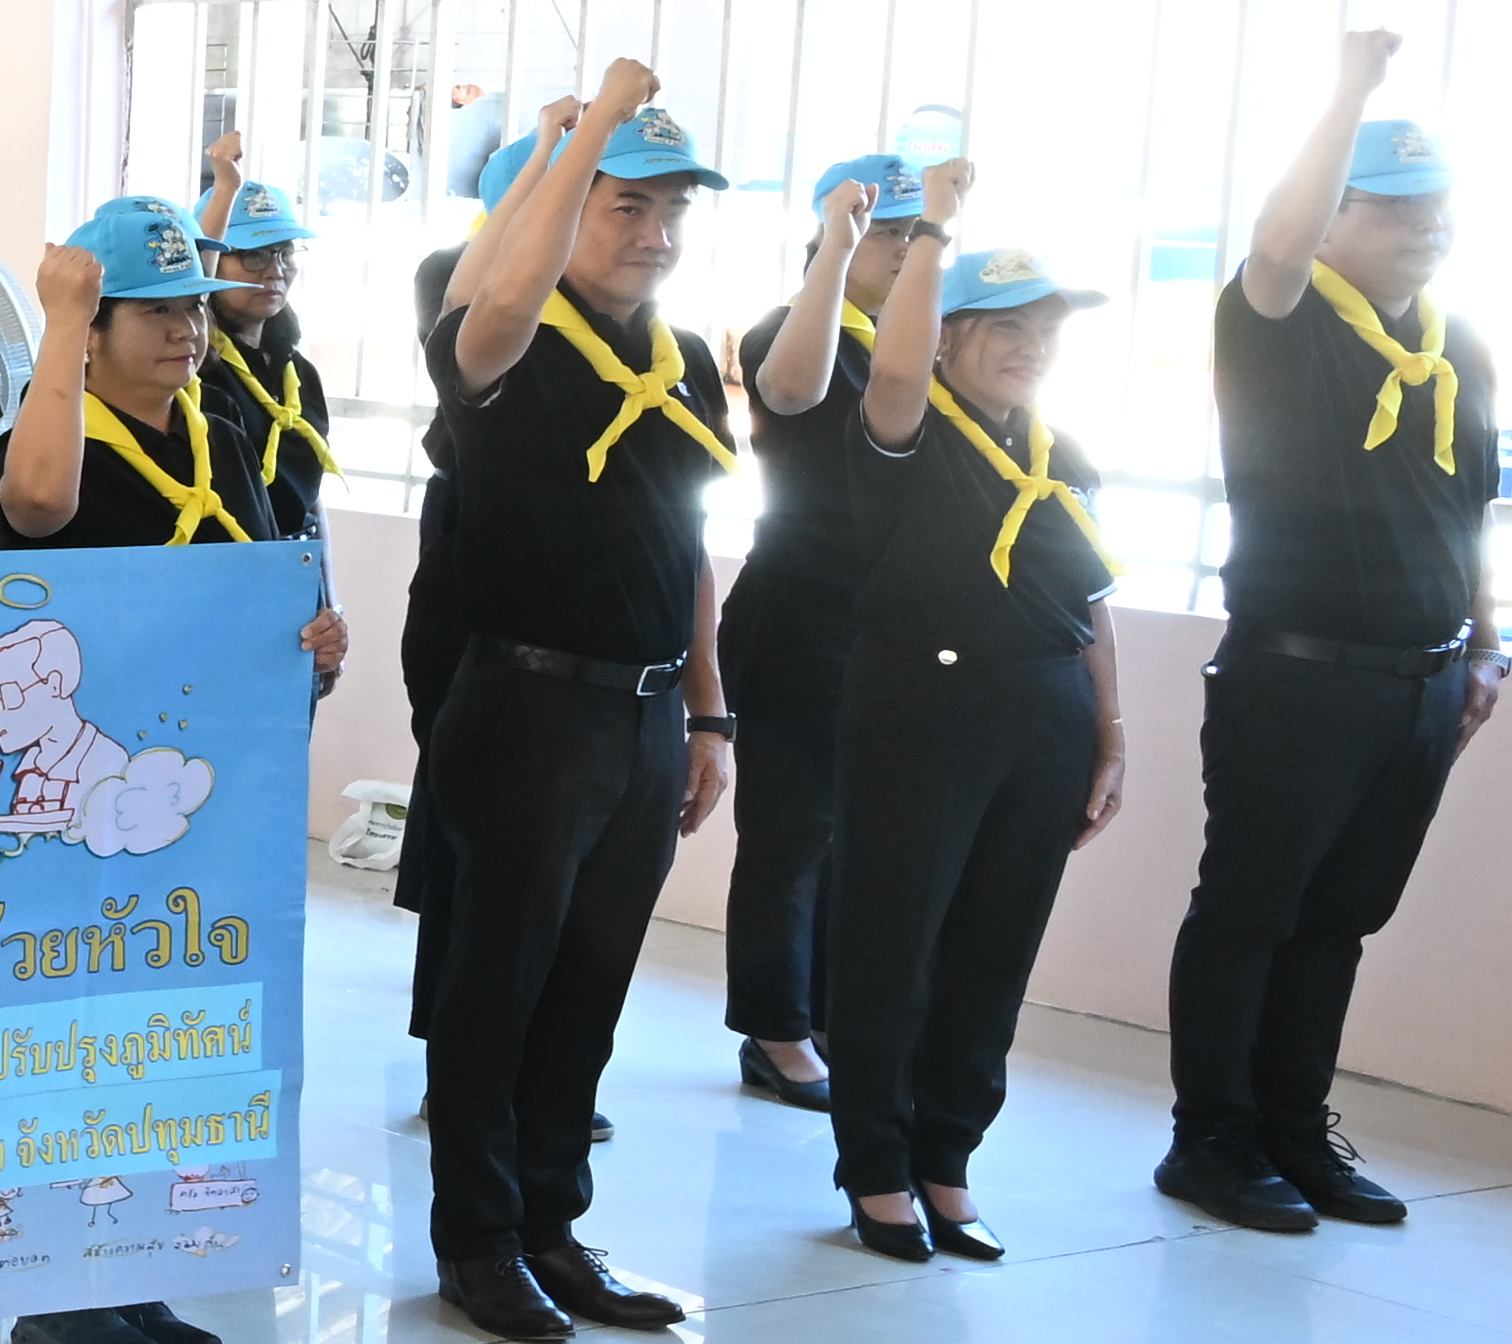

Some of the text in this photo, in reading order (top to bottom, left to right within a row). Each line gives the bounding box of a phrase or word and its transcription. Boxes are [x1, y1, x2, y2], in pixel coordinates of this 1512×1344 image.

[16, 1090, 272, 1168] จังหวัดปทุมธานี
